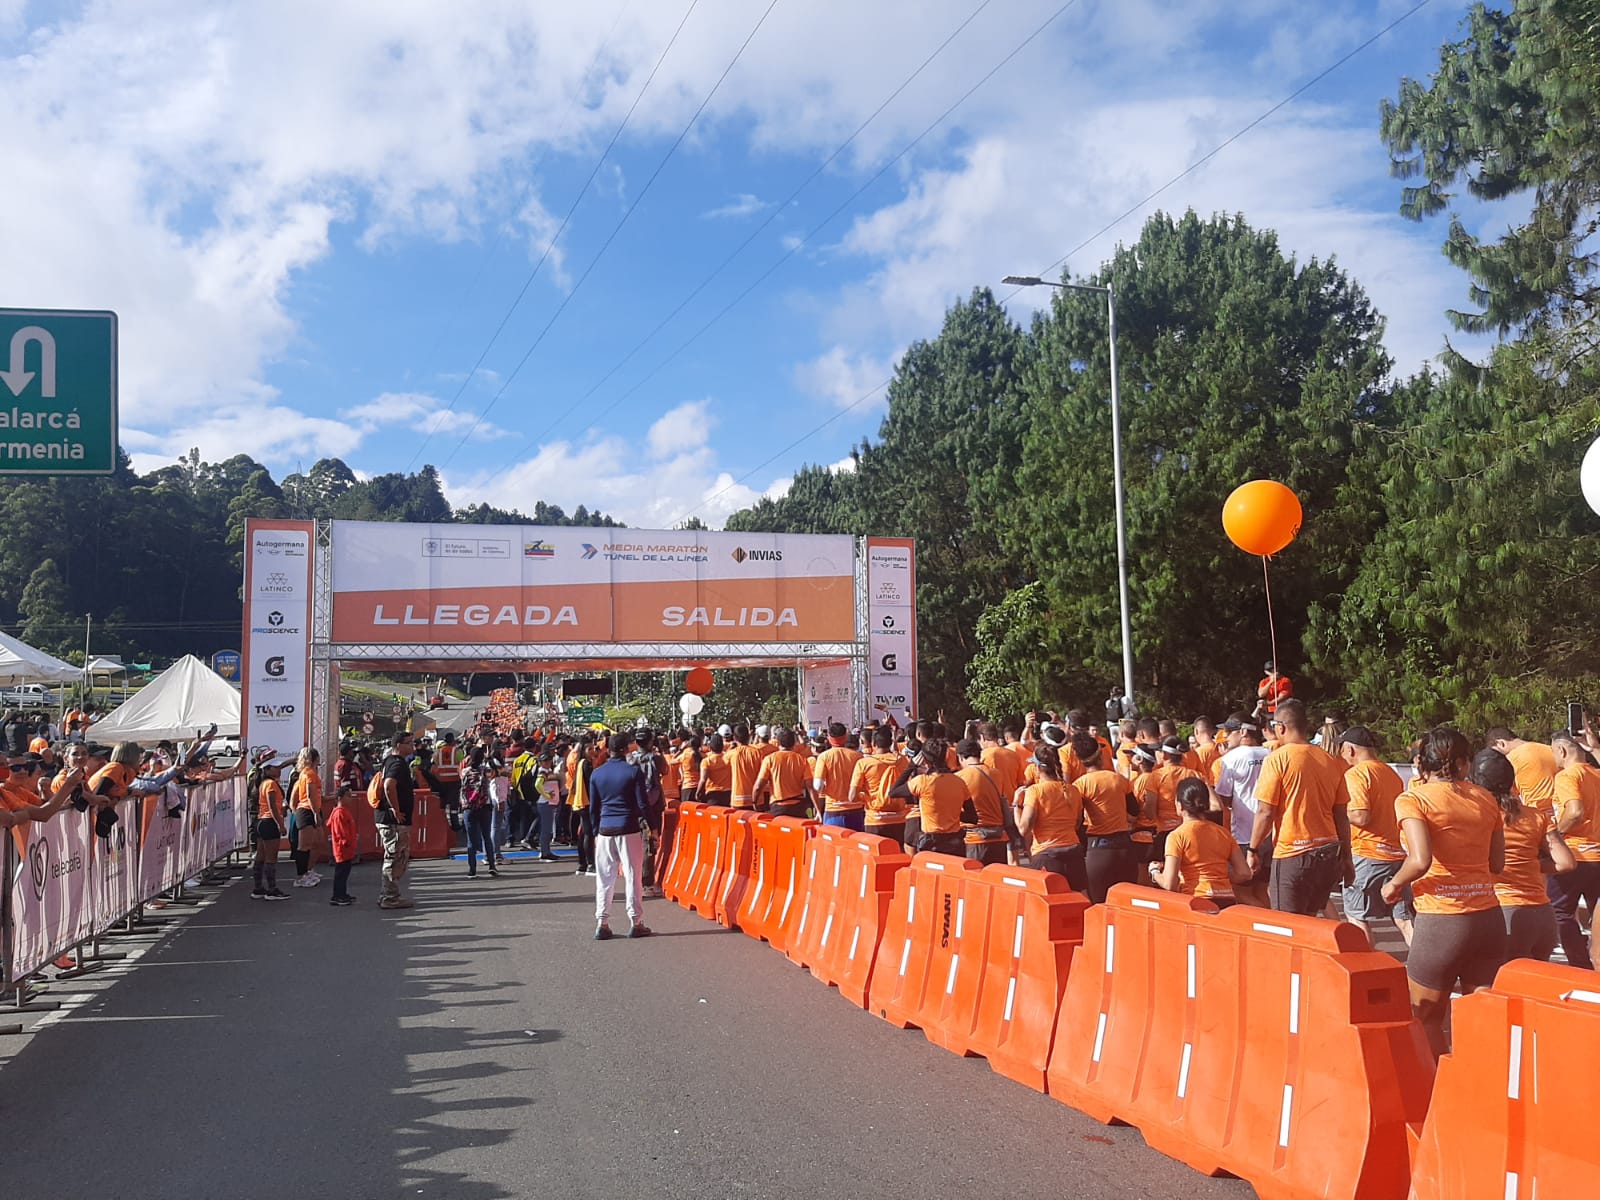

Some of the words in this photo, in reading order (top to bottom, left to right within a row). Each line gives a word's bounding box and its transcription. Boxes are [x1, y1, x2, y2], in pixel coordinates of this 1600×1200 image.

[0, 407, 81, 429] alarcá
[0, 438, 85, 460] rmenia
[256, 540, 305, 548] Autogermana
[603, 544, 643, 552] MEDIA
[647, 544, 709, 553] MARATÓN
[603, 552, 640, 561] TÚNEL
[677, 554, 709, 562] LÍNEA
[749, 550, 783, 561] INVIAS
[373, 604, 579, 626] LLEGADA
[661, 606, 799, 627] SALIDA
[265, 656, 285, 677] G
[882, 654, 897, 671] G
[942, 893, 952, 949] INVIAS
